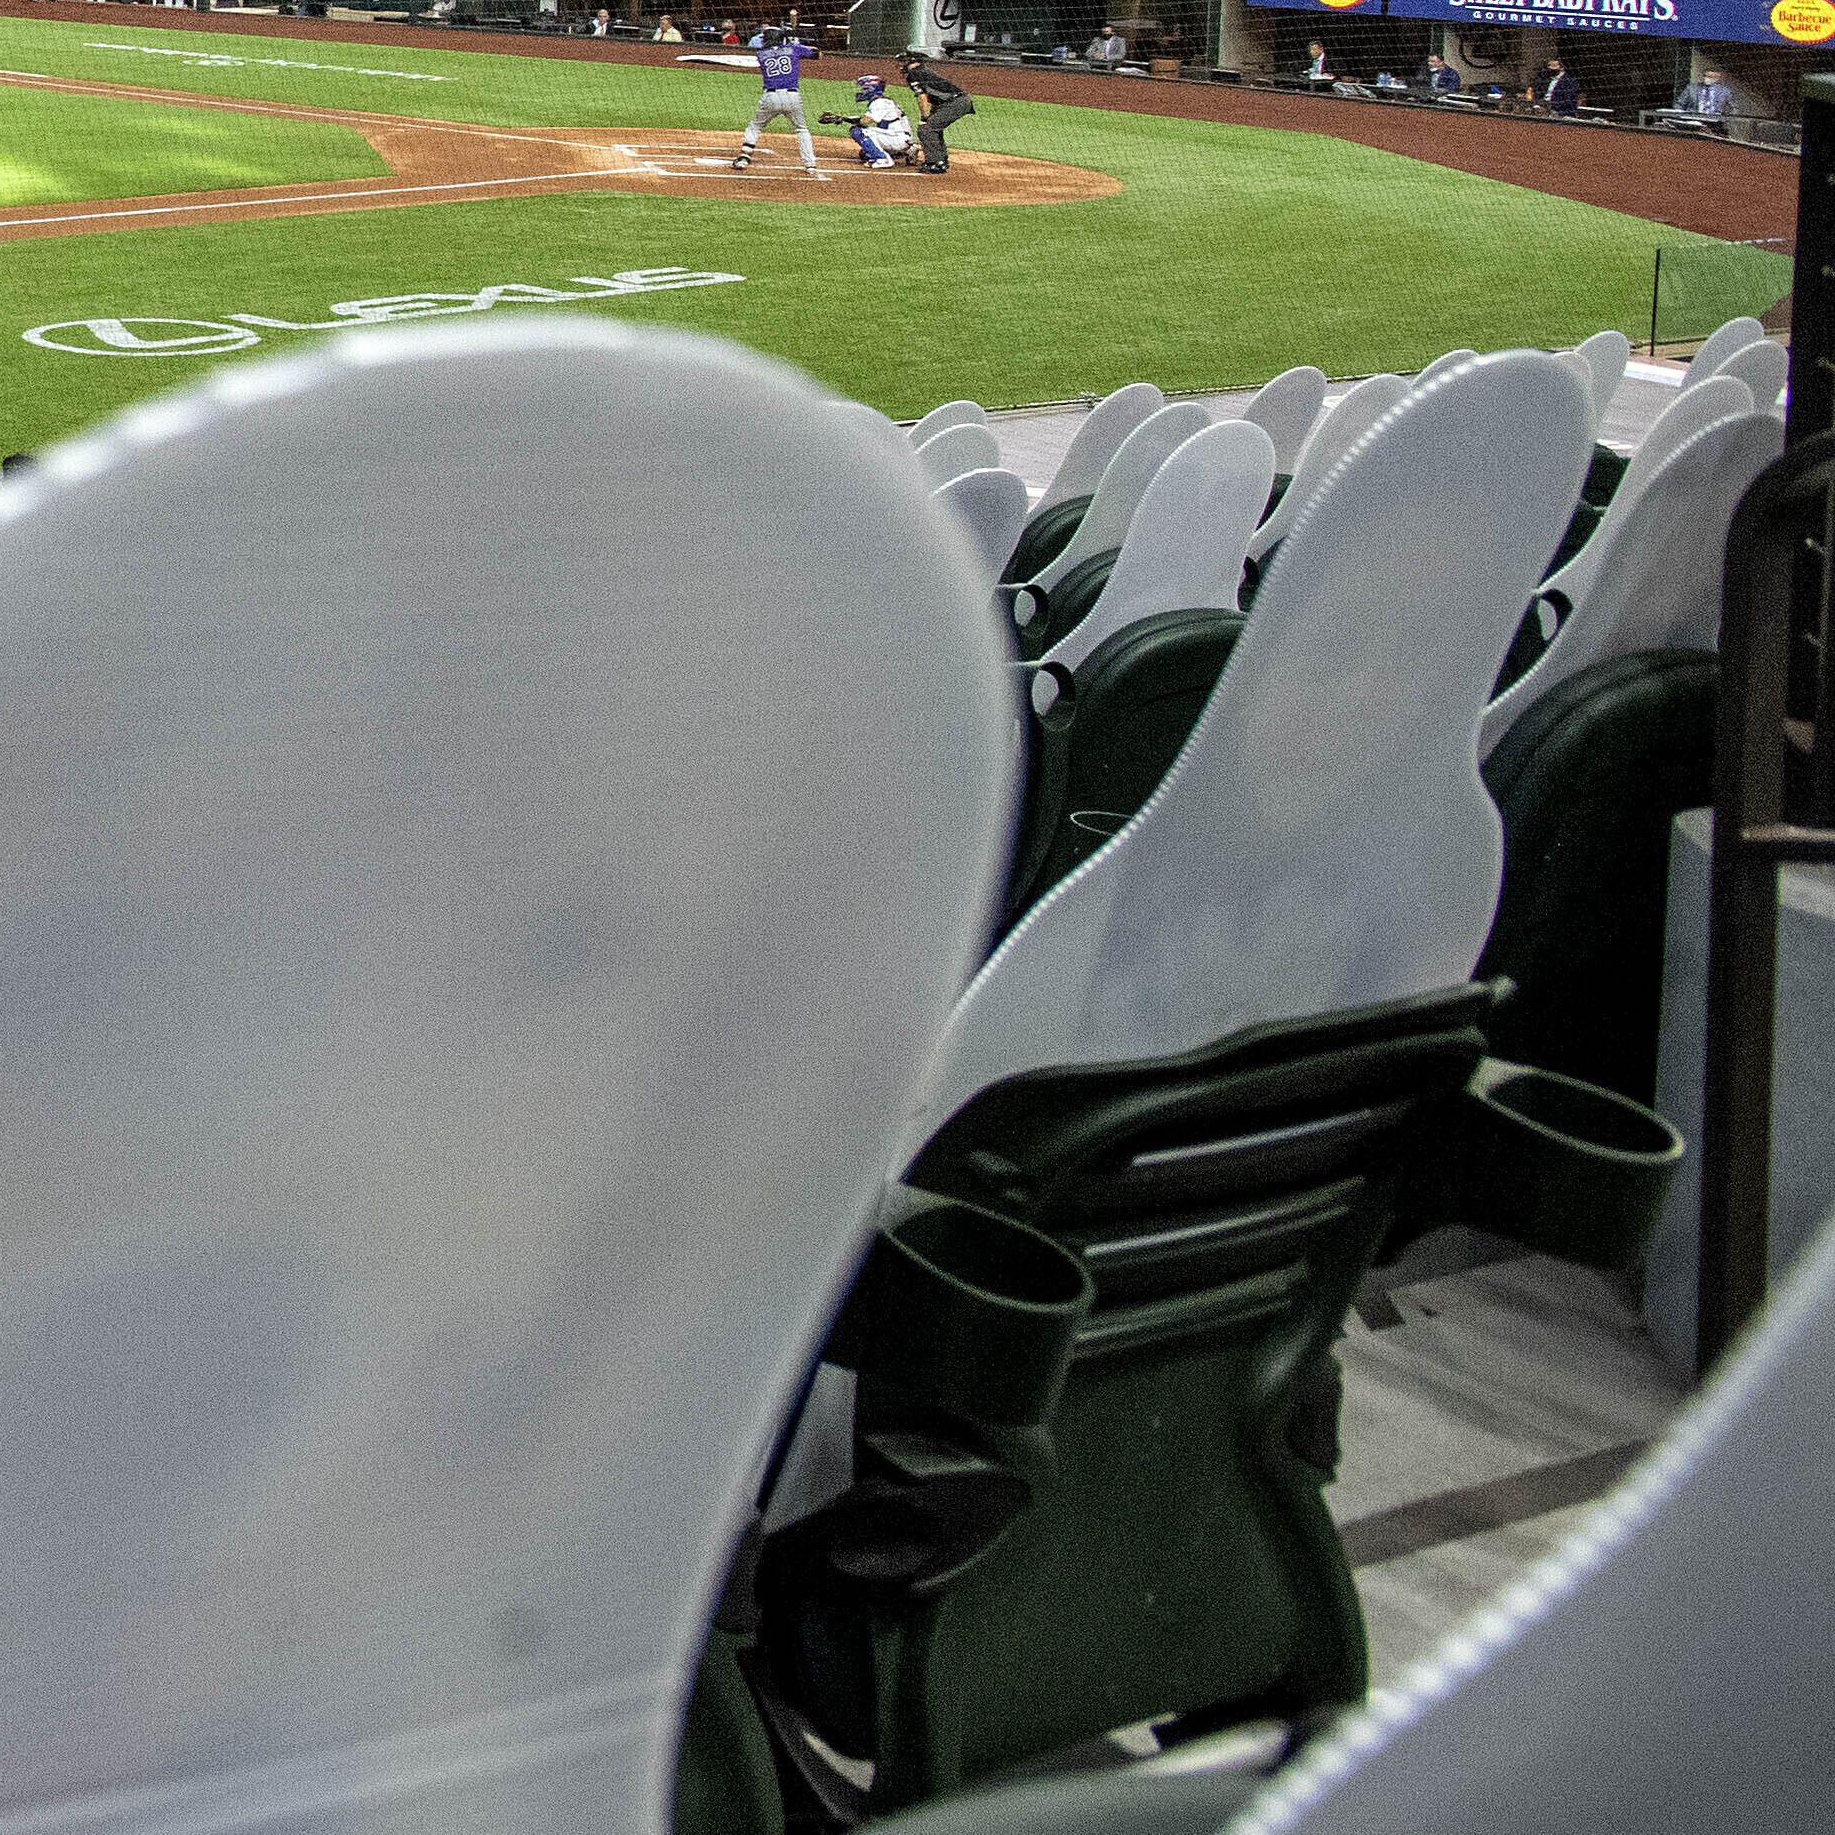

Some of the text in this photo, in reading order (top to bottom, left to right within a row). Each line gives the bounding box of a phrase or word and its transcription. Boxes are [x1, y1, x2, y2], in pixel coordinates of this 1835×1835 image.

[1473, 11, 1639, 30] GOURMET SAUCES
[1778, 9, 1832, 25] Barbecue
[1787, 20, 1822, 33] Sauce
[762, 56, 790, 77] 28
[220, 265, 747, 331] LEXUS
